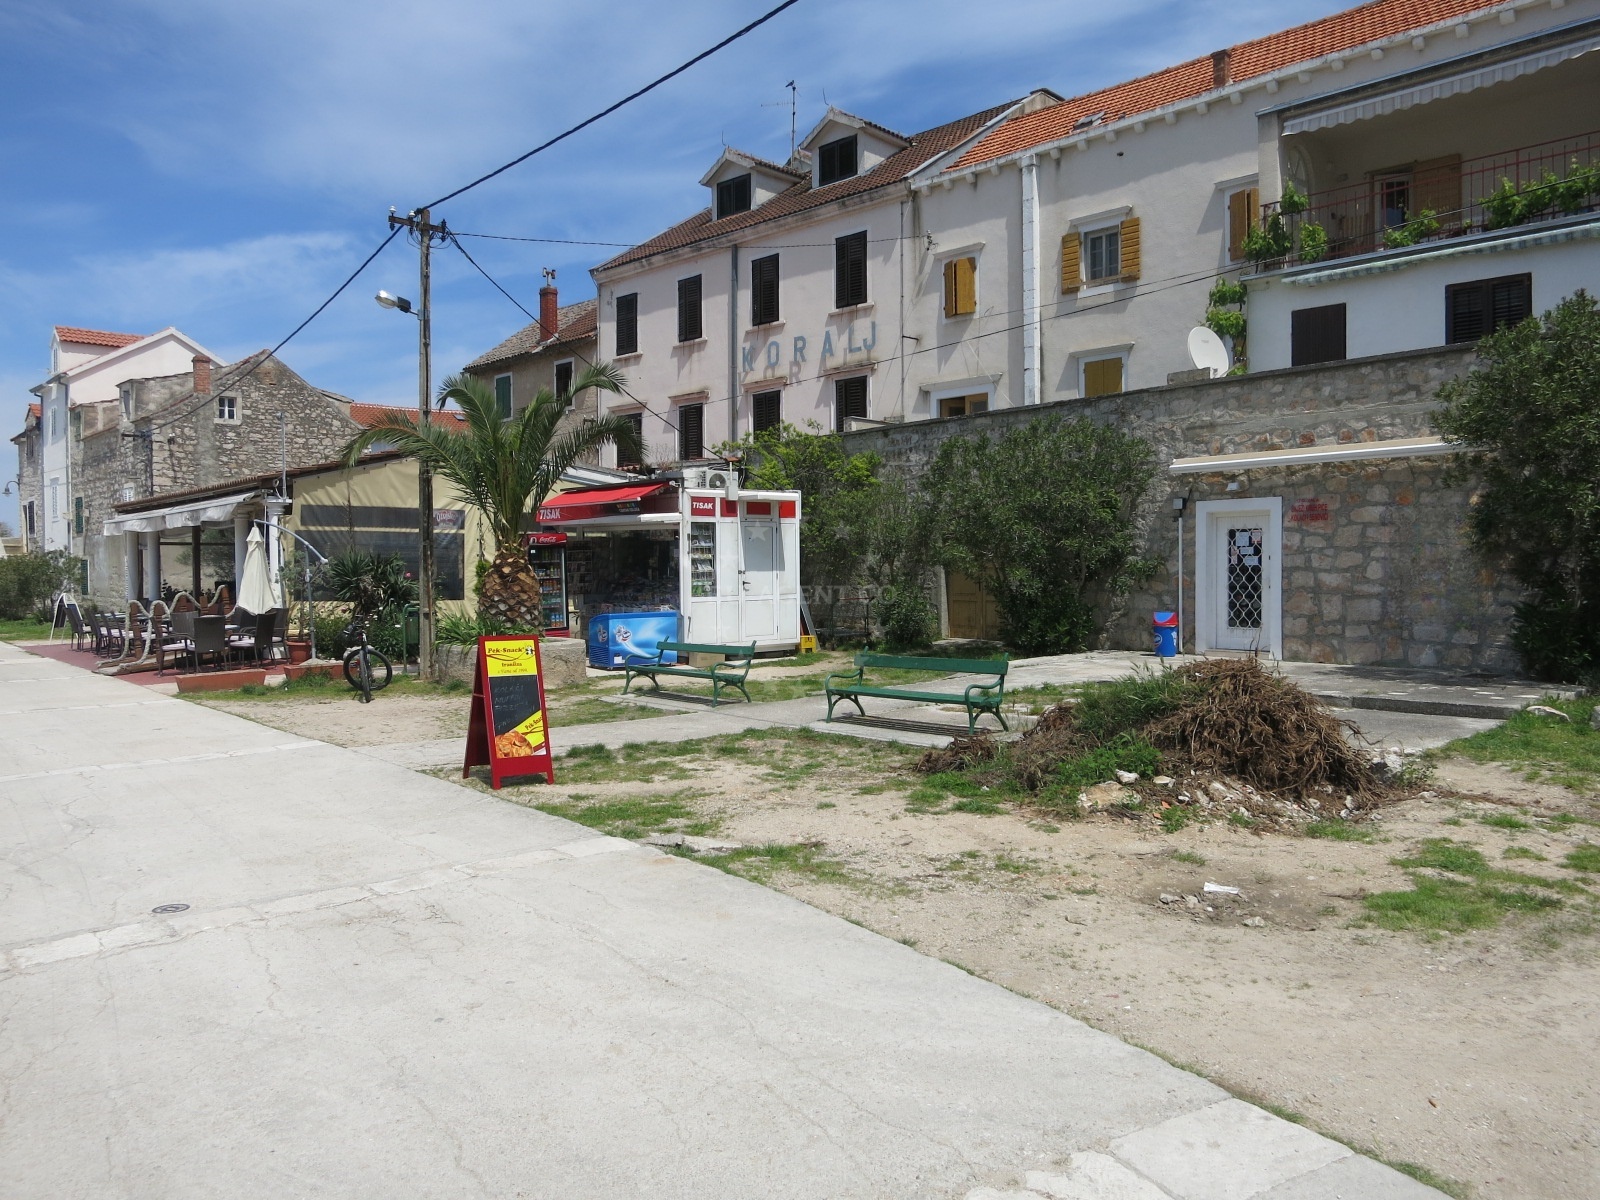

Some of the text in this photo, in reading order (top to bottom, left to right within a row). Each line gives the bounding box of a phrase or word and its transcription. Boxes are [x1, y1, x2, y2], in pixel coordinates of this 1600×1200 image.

[742, 320, 876, 372] KORALJ
[692, 501, 714, 510] TISAK
[540, 508, 561, 520] TISAK
